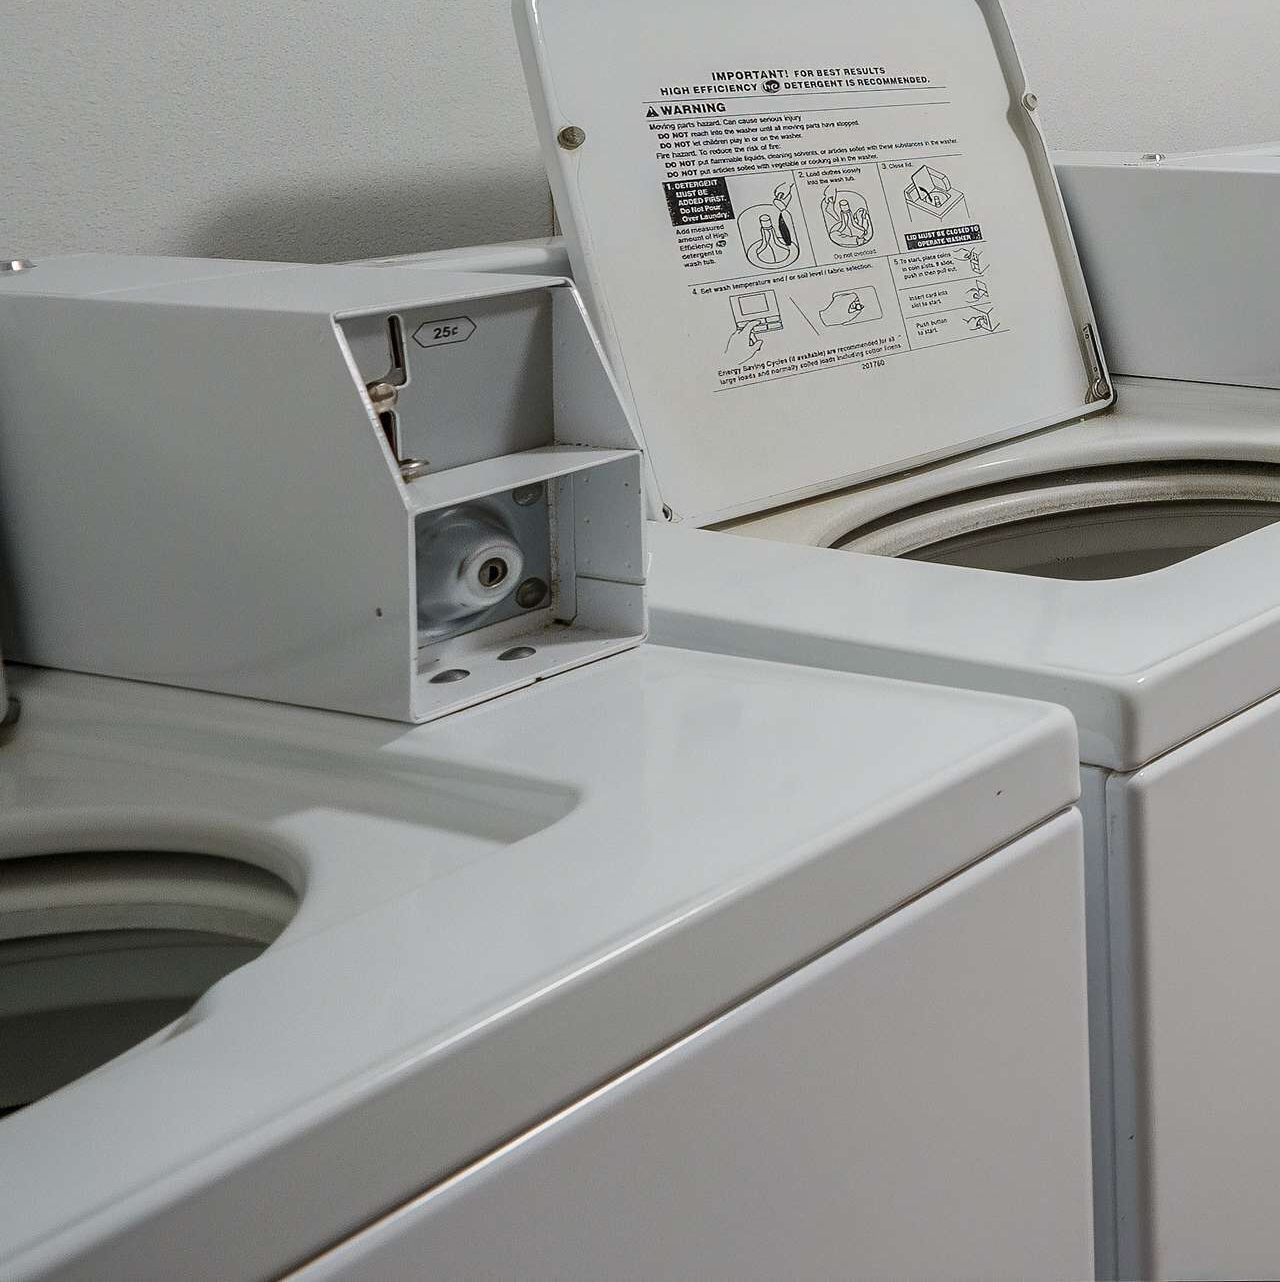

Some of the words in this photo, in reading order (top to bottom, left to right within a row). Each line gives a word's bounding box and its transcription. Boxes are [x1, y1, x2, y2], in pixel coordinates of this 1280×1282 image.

[712, 70, 788, 81] IMPORTANT!
[844, 67, 885, 75] RESULTS
[661, 87, 689, 95] HIGH
[694, 84, 757, 94] EFFICIENCY
[784, 79, 842, 89] DETERGENT
[858, 76, 930, 86] RECOMMENDED.
[661, 103, 726, 116] WARNING
[675, 180, 718, 189] DETERGENT
